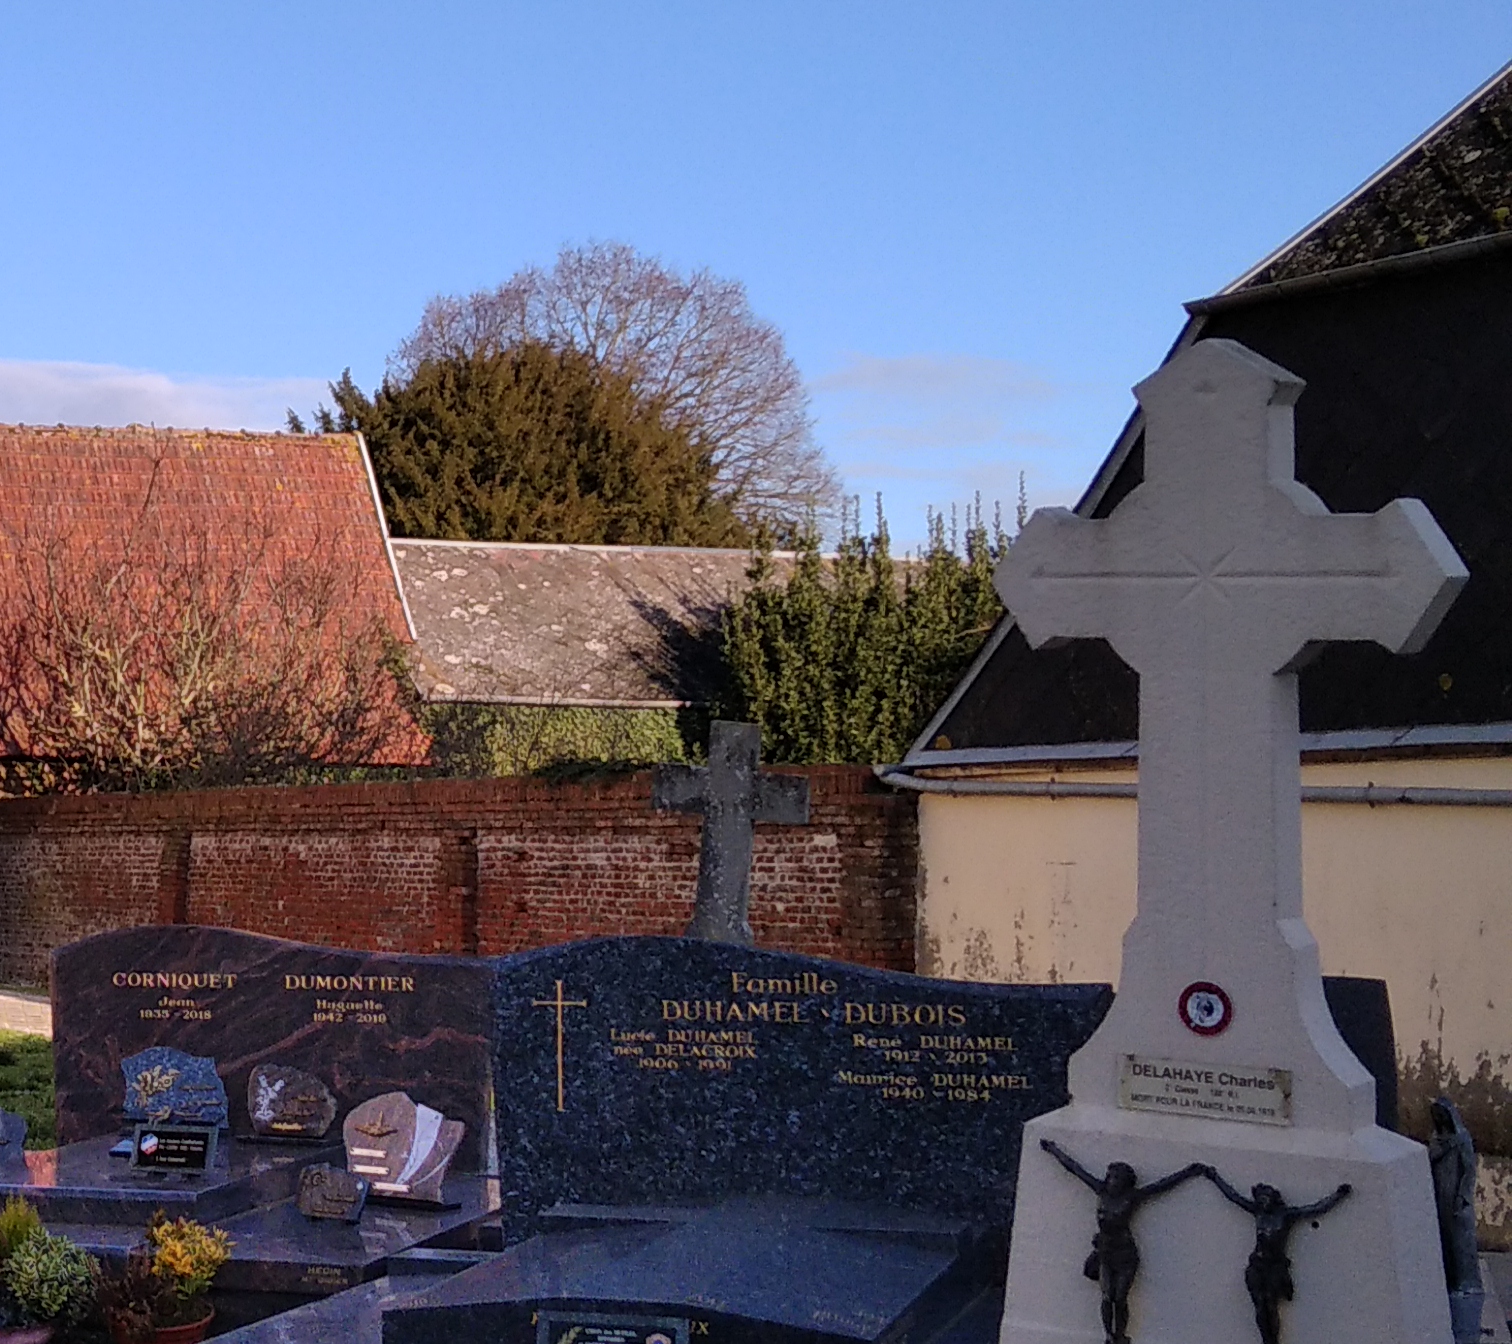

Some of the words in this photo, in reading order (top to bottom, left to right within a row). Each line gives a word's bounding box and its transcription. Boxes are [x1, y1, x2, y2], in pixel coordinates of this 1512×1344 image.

[112, 971, 238, 990] CORNIQUET
[285, 974, 415, 992] DUMONTIER
[731, 970, 839, 995] Famille
[157, 995, 195, 1007] Jean
[316, 998, 384, 1013] Huguette
[182, 1009, 212, 1020] 2018
[660, 999, 809, 1023] DUHAMEL
[844, 1001, 967, 1026] DUBOIS
[610, 1027, 656, 1042] Lucie
[667, 1028, 756, 1043] DUHAMEL
[920, 1034, 1019, 1051] DUHAMEL
[655, 1043, 758, 1059] DELACROIX
[884, 1050, 921, 1063] 1912
[838, 1070, 919, 1086] Maurice
[932, 1072, 1034, 1090] DUHAMEL
[1132, 1063, 1213, 1084] DELAHAYE
[1218, 1072, 1276, 1091] Charles
[881, 1086, 926, 1099] 1940
[947, 1088, 992, 1102] 1984
